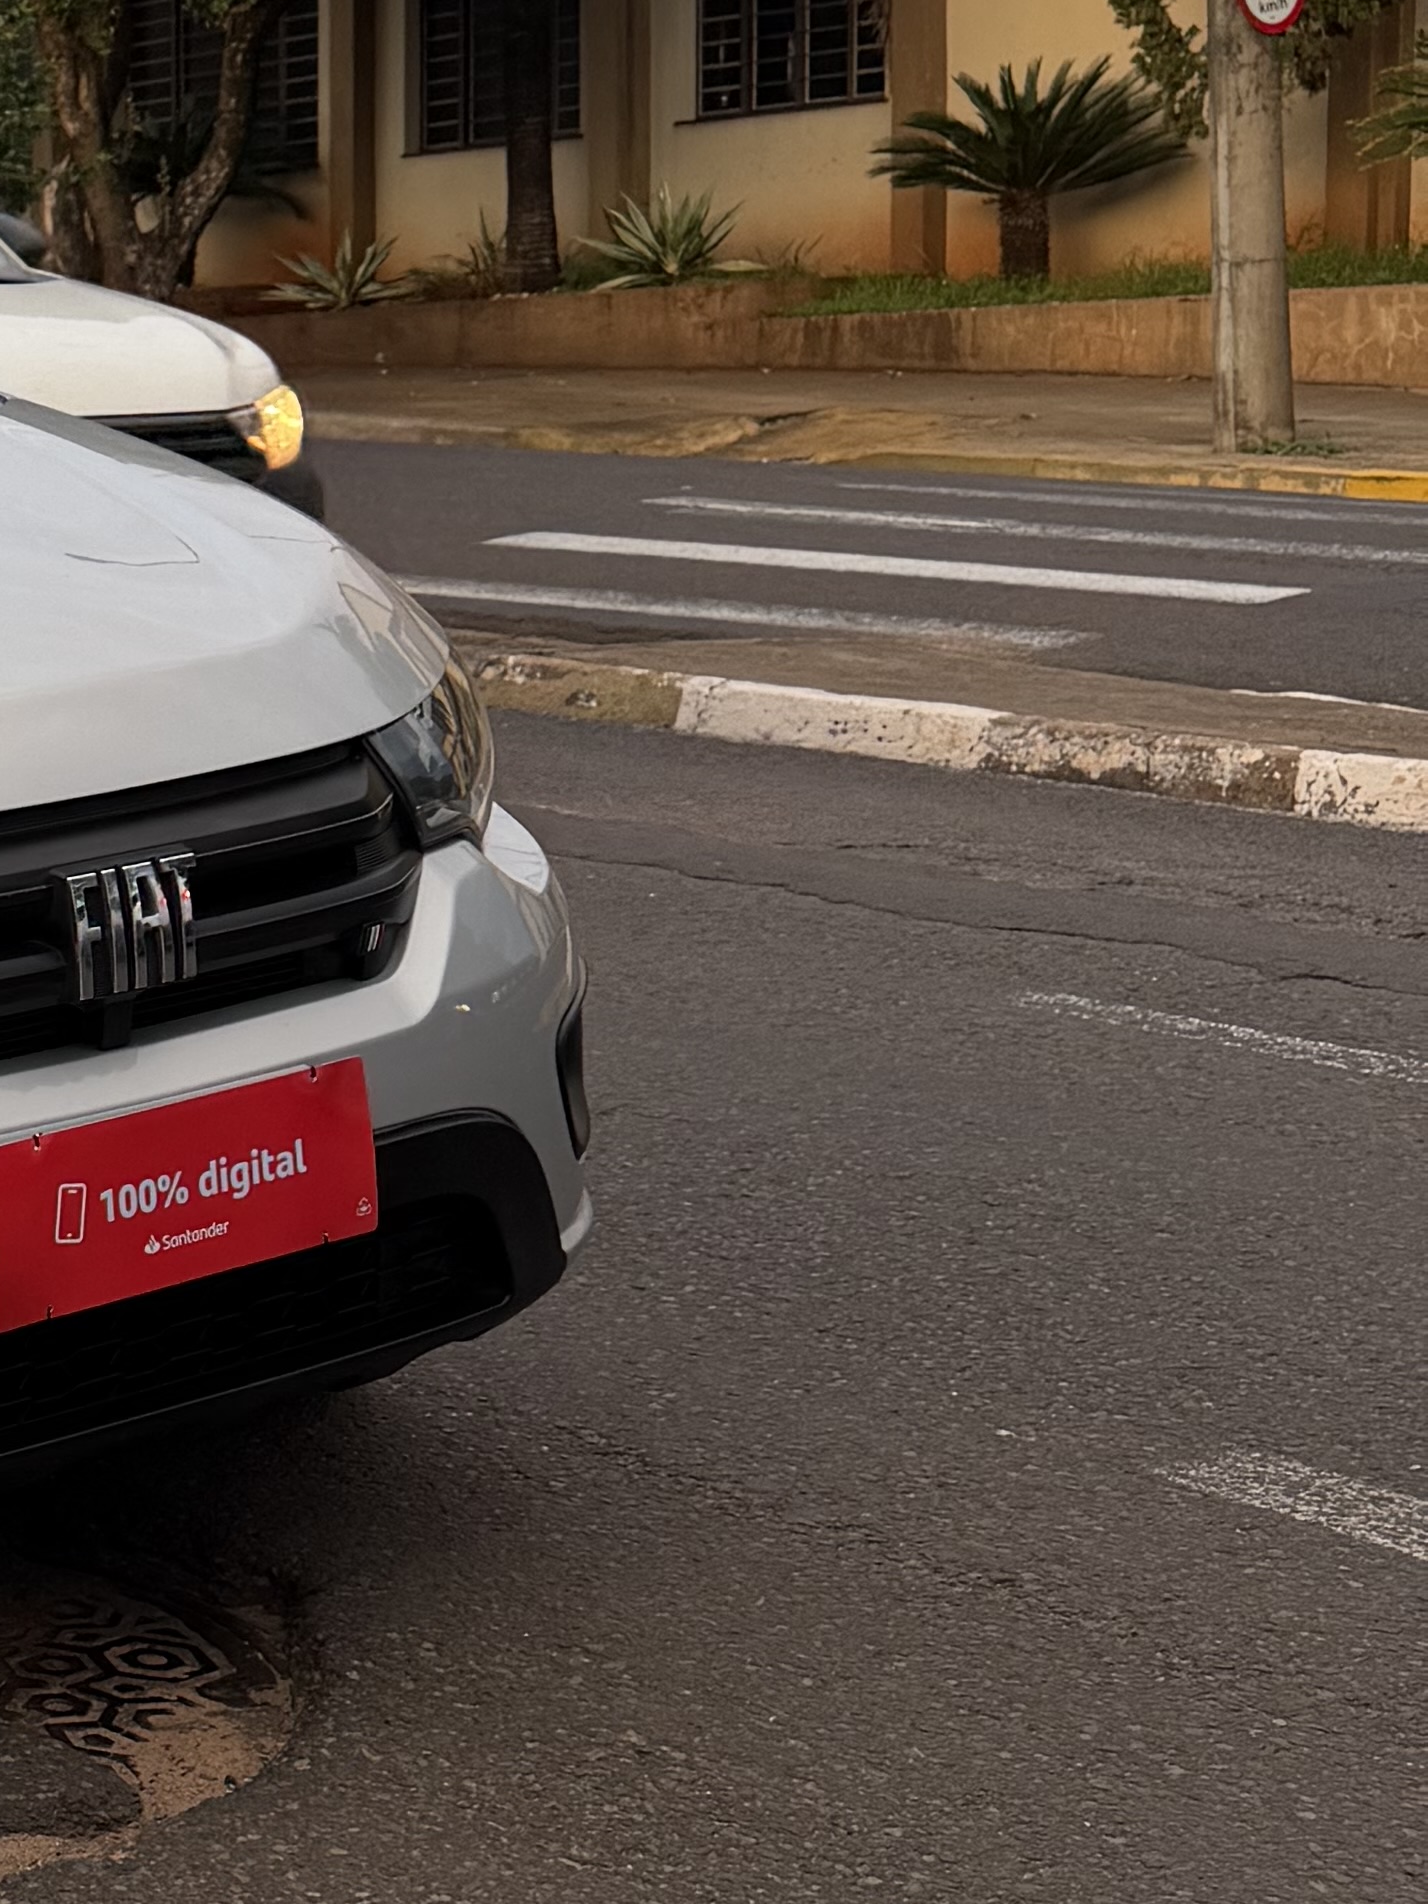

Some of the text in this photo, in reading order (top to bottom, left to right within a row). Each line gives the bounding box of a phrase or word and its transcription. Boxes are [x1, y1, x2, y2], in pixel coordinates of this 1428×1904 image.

[66, 853, 197, 1001] FIAT
[100, 1138, 307, 1223] 100% digital
[162, 1221, 229, 1251] Santander
